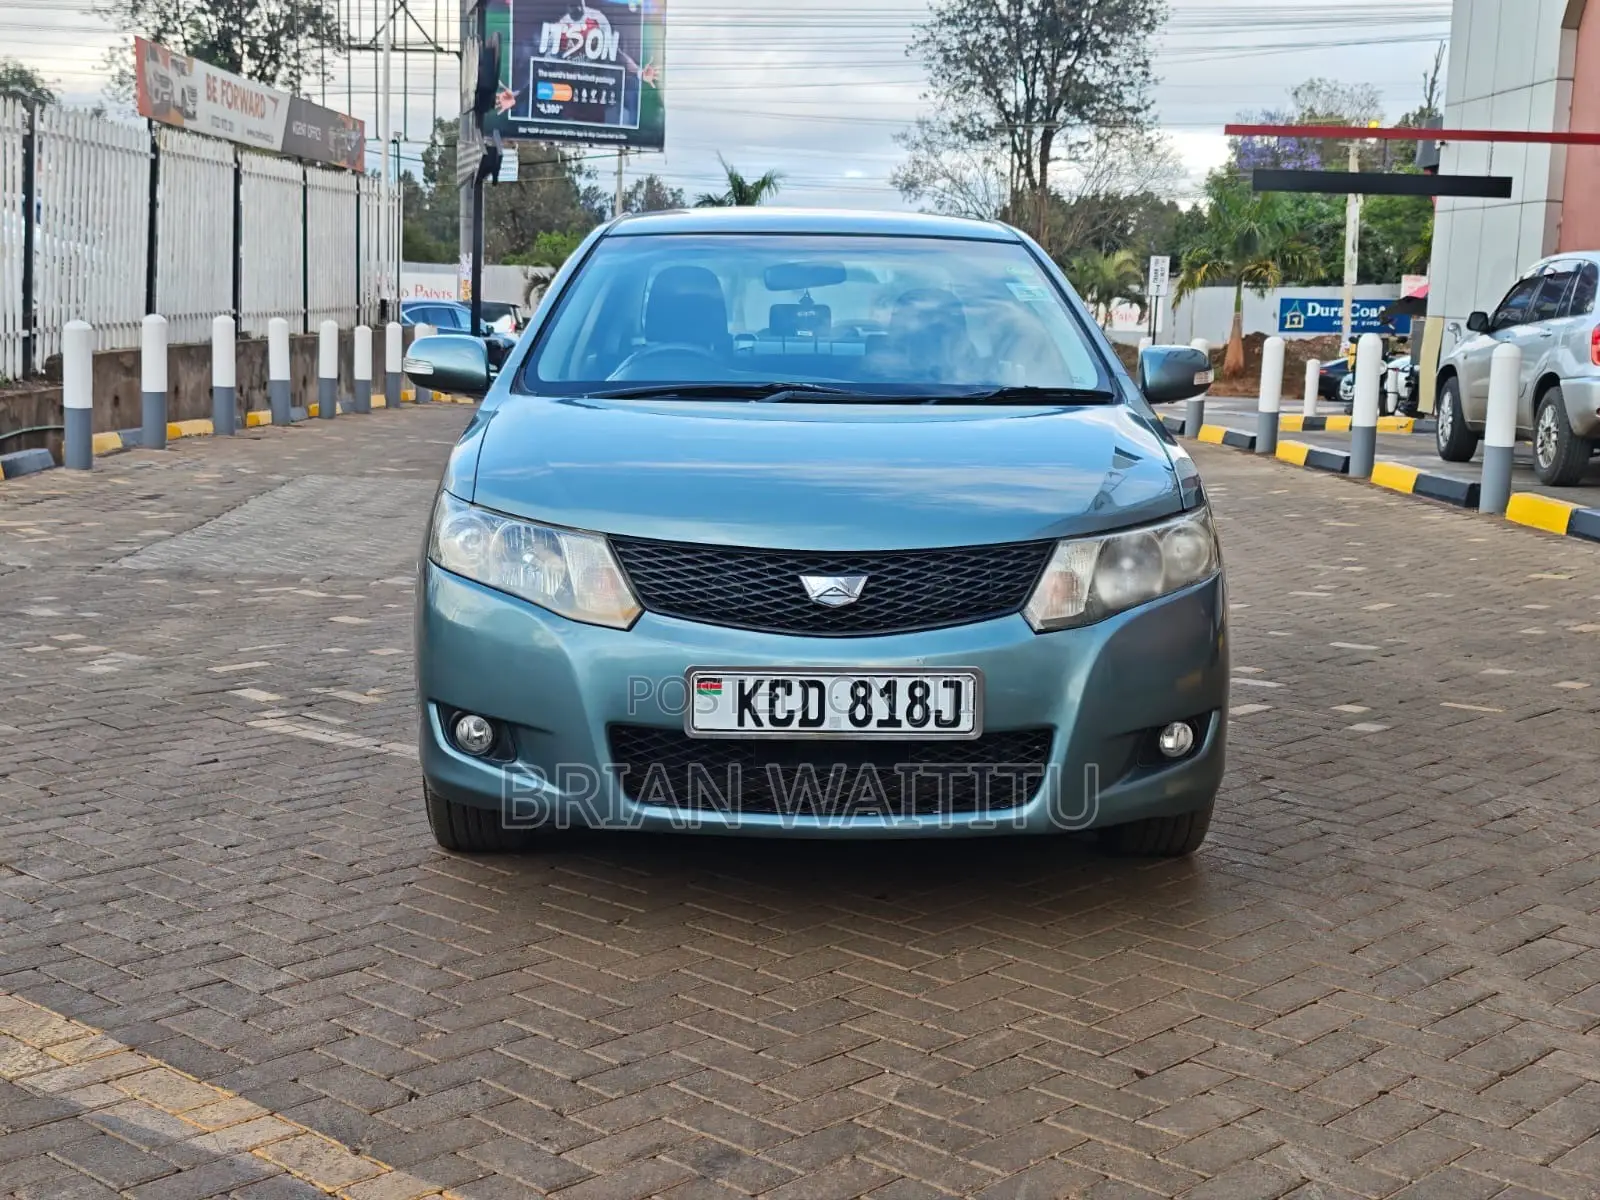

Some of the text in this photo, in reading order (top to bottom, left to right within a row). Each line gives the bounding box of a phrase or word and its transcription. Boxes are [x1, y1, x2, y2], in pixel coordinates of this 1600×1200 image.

[585, 29, 619, 62] ON
[205, 73, 266, 120] BE FORWARD
[737, 679, 962, 729] KCD 818J
